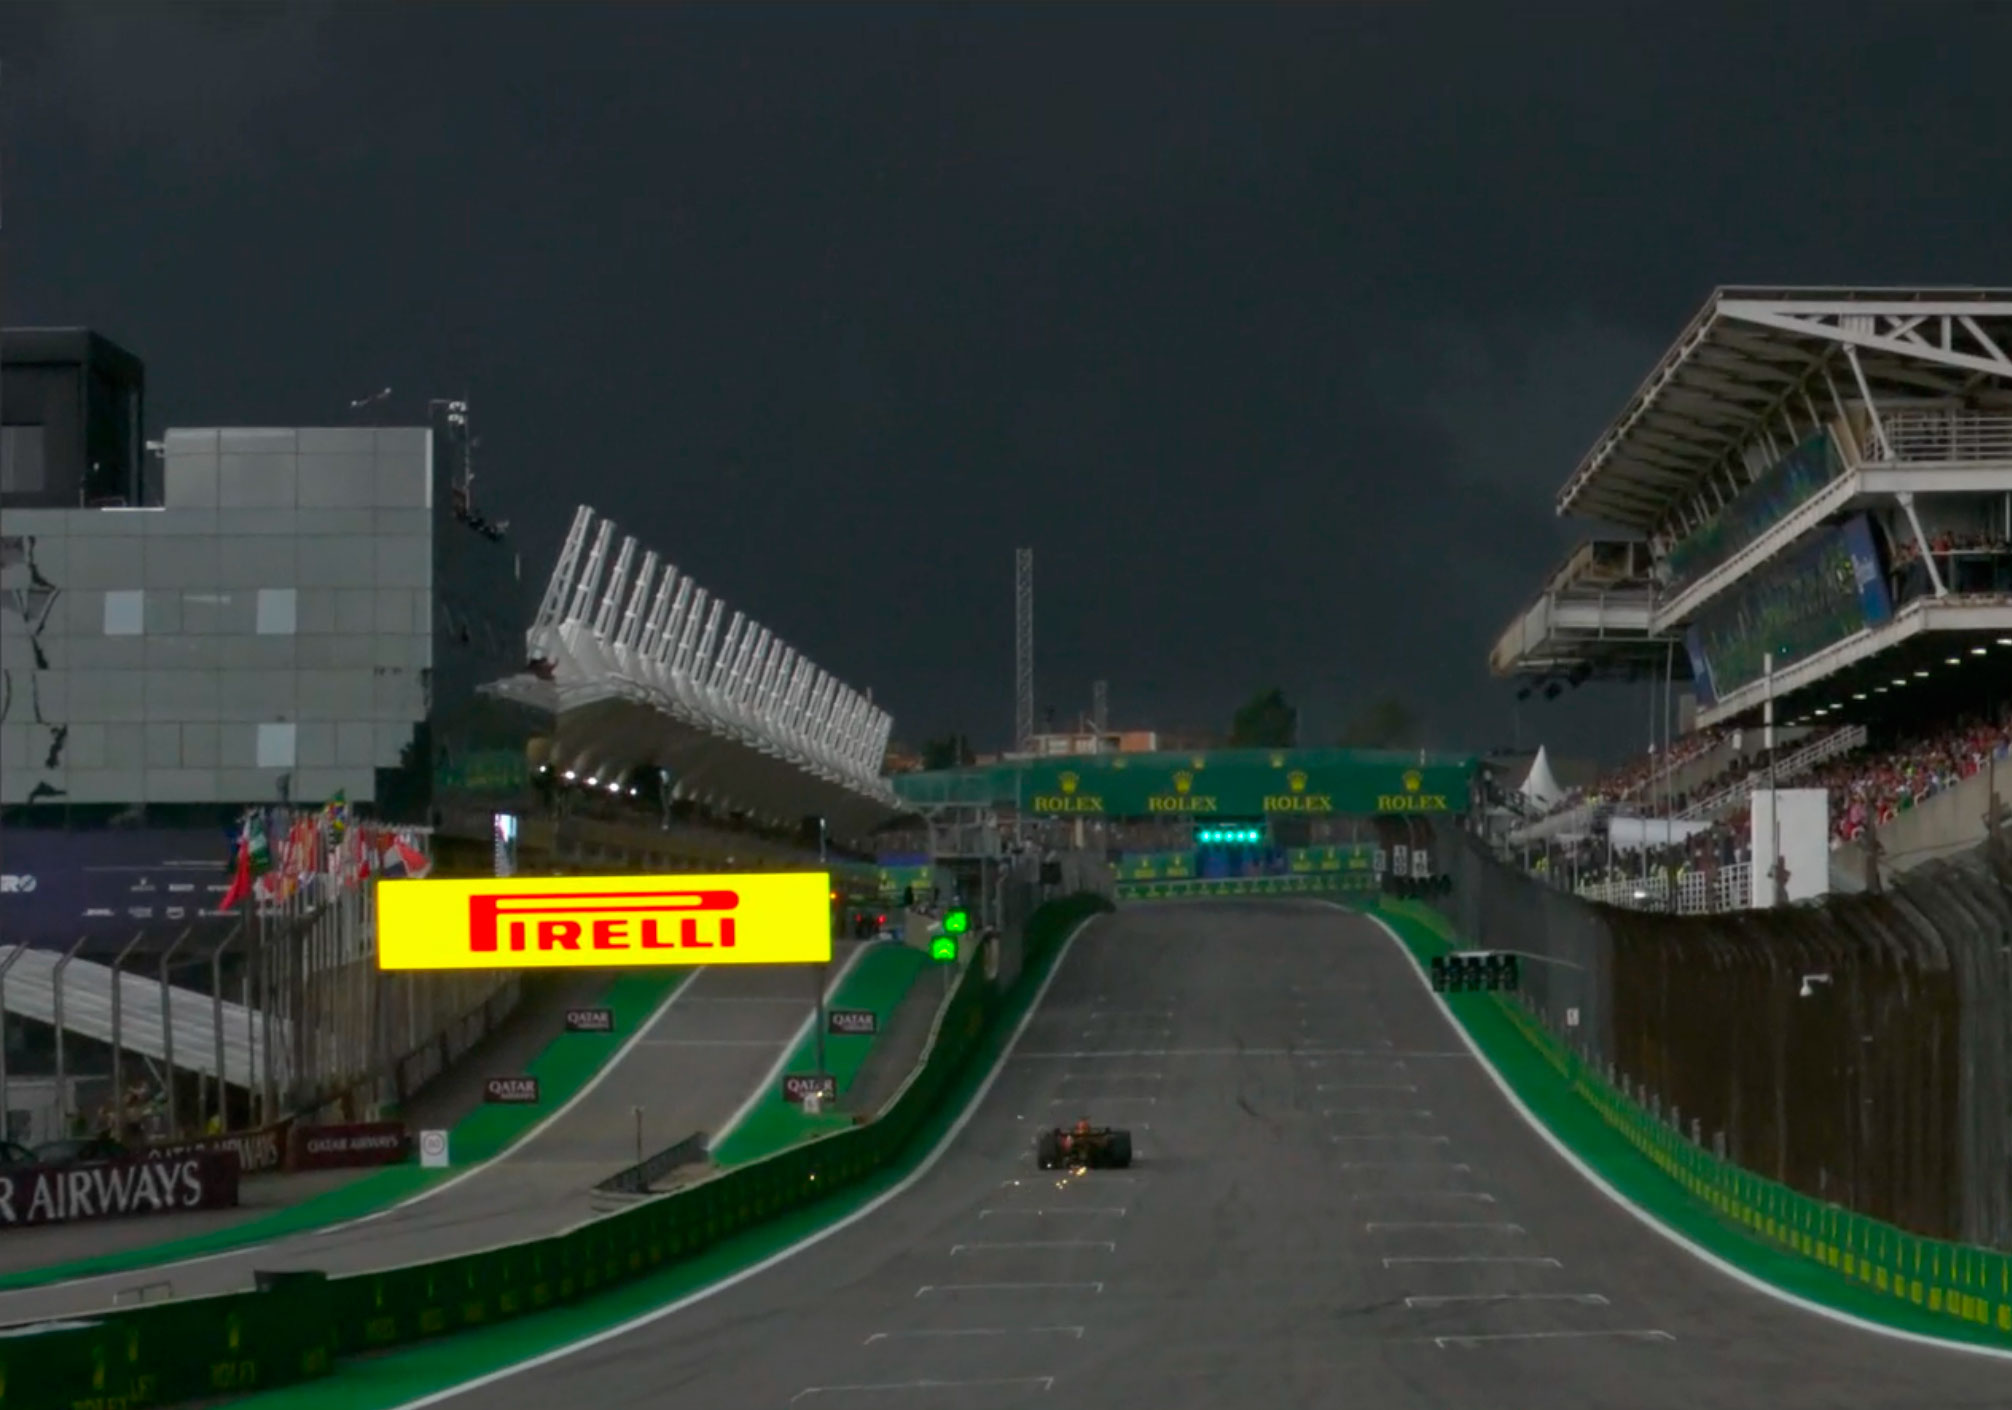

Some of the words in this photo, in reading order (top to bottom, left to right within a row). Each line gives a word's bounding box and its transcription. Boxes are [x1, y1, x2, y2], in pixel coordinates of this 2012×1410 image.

[1034, 796, 1103, 812] ROLEX
[1148, 796, 1218, 812] ROLEX
[1263, 795, 1333, 811] ROLEX
[1377, 795, 1447, 810] ROLEX
[469, 890, 740, 952] PIRELLI
[566, 1011, 609, 1024] QATAR
[832, 1013, 873, 1025] QATAR
[488, 1080, 535, 1093] QATAR
[27, 1160, 202, 1222] AIRWAYS
